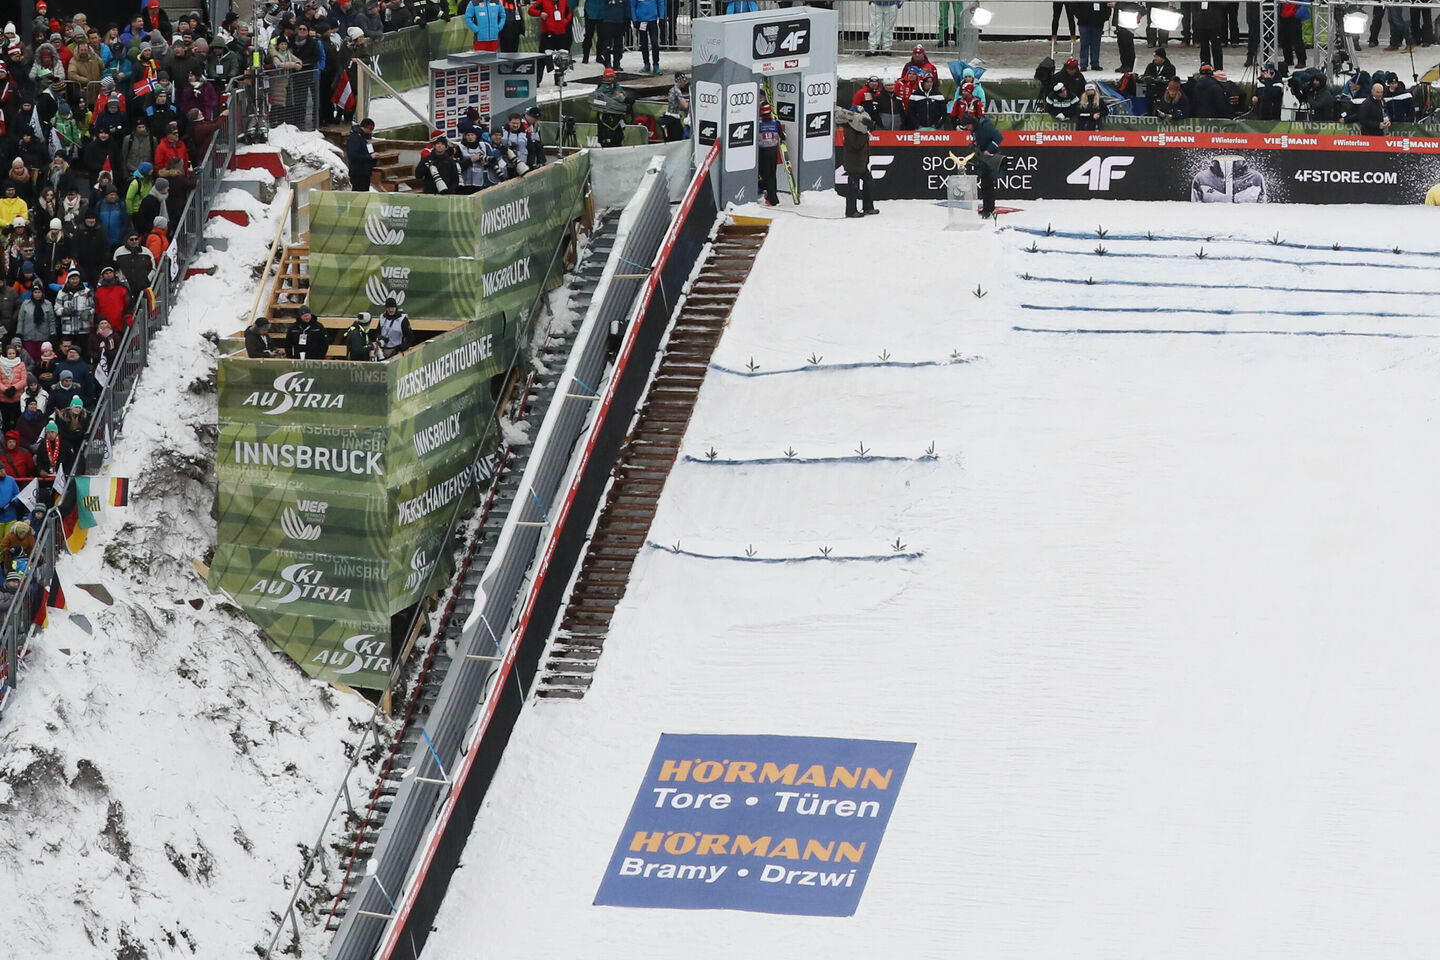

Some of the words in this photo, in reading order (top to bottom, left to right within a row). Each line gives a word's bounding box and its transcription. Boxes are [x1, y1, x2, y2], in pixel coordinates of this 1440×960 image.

[780, 30, 807, 52] 4F
[515, 63, 533, 73] 4F
[779, 106, 792, 115] 4F
[810, 115, 827, 129] 4F
[702, 127, 715, 136] 4F
[732, 125, 750, 139] 4F
[896, 132, 949, 144] VIESSMANN
[1019, 132, 1072, 145] VIESSMANN
[1142, 133, 1195, 146] VIESSMANN
[1264, 135, 1317, 147] VIESSMANN
[1386, 139, 1439, 151] VIESSMANN
[1067, 156, 1135, 190] 4F
[1294, 169, 1397, 185] 4FSTORE.COM
[380, 205, 411, 218] VIER
[481, 196, 531, 236] INNSBRUCK
[381, 266, 411, 279] VIER
[482, 256, 531, 298] INNSBRUCK
[396, 333, 493, 401] VIERSCHANZENTOURNEE
[351, 371, 387, 383] INNSB
[242, 392, 345, 415] AUSTRIA
[413, 412, 460, 457] INNSBRUCK
[235, 441, 383, 476] INNSBRUCK
[297, 499, 328, 513] VIER
[334, 563, 388, 577] INNSBRU
[250, 578, 352, 604] AUSTRIA
[312, 649, 391, 675] AUSTR
[658, 758, 893, 790] HÖRMANN
[652, 788, 731, 810] Tore
[774, 791, 880, 818] Türen
[629, 830, 866, 863] HÖRMANN
[619, 857, 728, 883] Bramy
[760, 864, 856, 888] Drzwi
